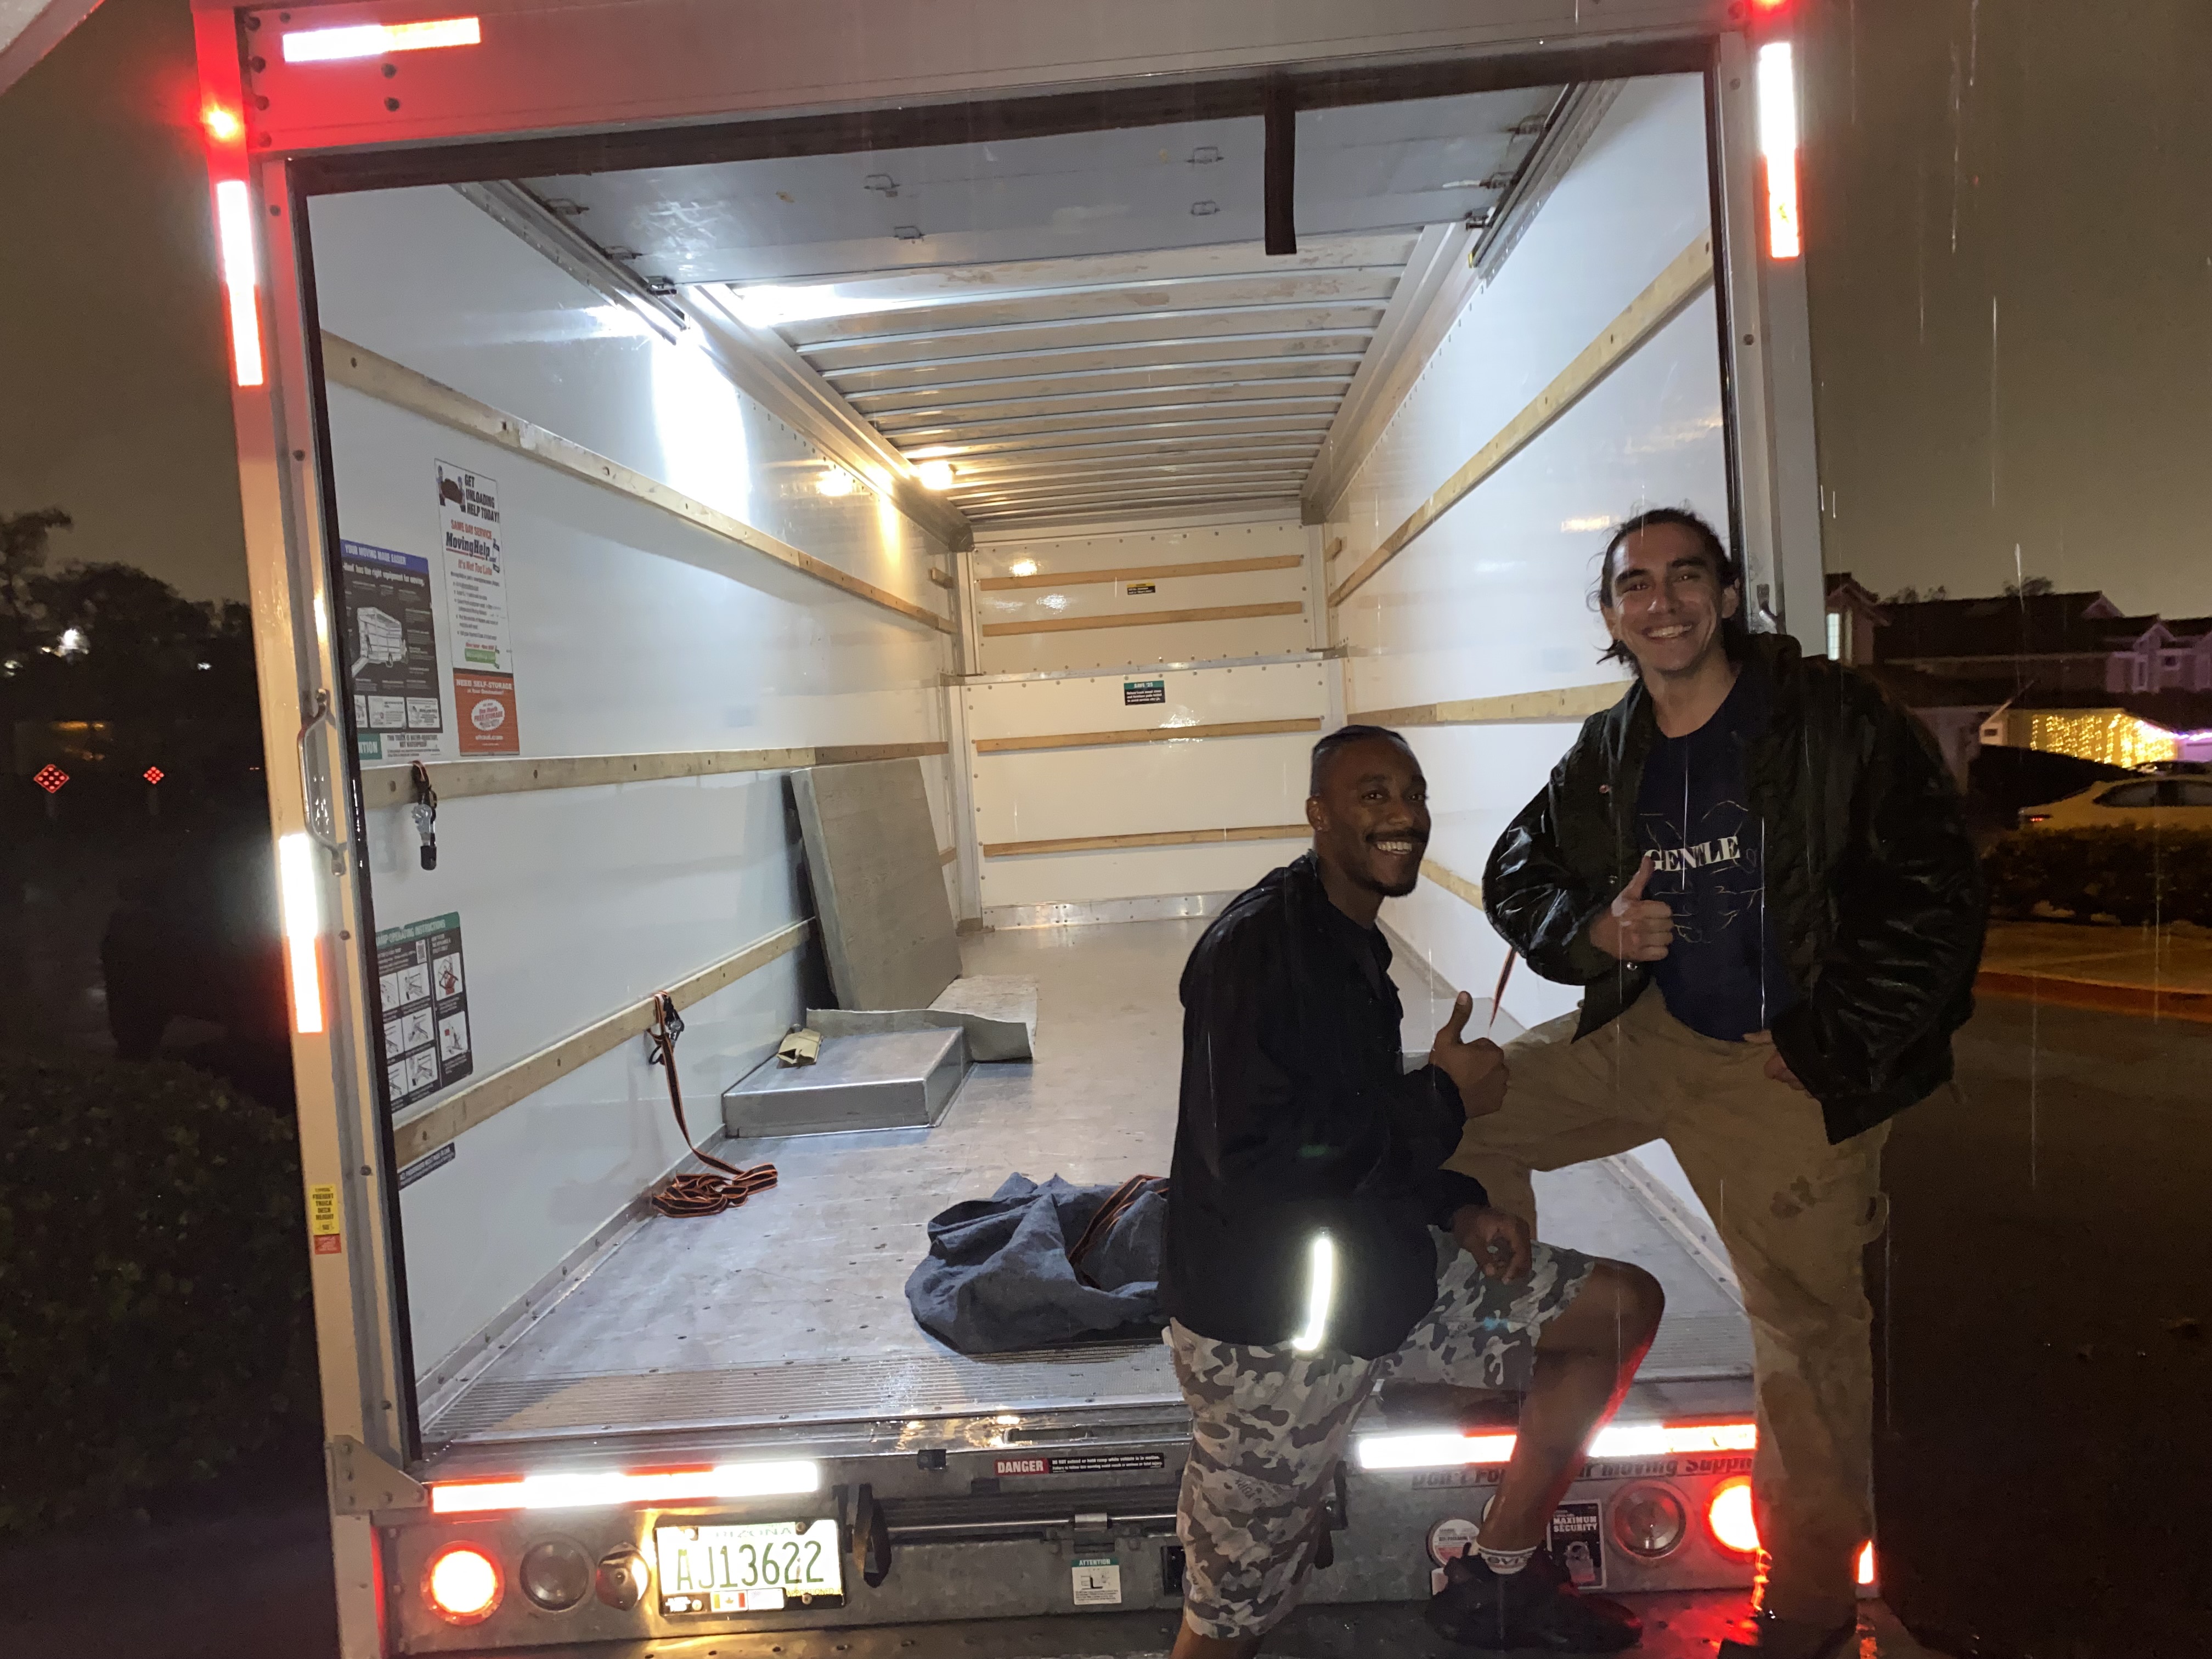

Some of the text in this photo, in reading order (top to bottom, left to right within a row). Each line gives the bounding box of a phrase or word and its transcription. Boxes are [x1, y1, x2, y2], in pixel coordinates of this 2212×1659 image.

[465, 474, 474, 488] GET
[466, 488, 495, 509] UNLOADING
[467, 502, 500, 523] HELP TODAY!
[451, 519, 492, 540] SAME DAY SERVICE
[345, 544, 407, 565] YOUR MOVING MADE EASIER
[446, 532, 490, 561] MovingHelp
[343, 562, 354, 572] -Haul
[382, 571, 403, 582] equipment
[466, 561, 474, 572] Not
[482, 565, 492, 575] Late
[473, 680, 513, 690] SELF-STORAGE
[1644, 836, 1740, 872] GENTLE
[376, 934, 388, 946] AMP
[997, 1460, 1043, 1474] DANGER
[1553, 1516, 1597, 1525] MAXIMUM
[1554, 1523, 1598, 1532] SECURITY
[676, 1540, 824, 1591] AJ13622
